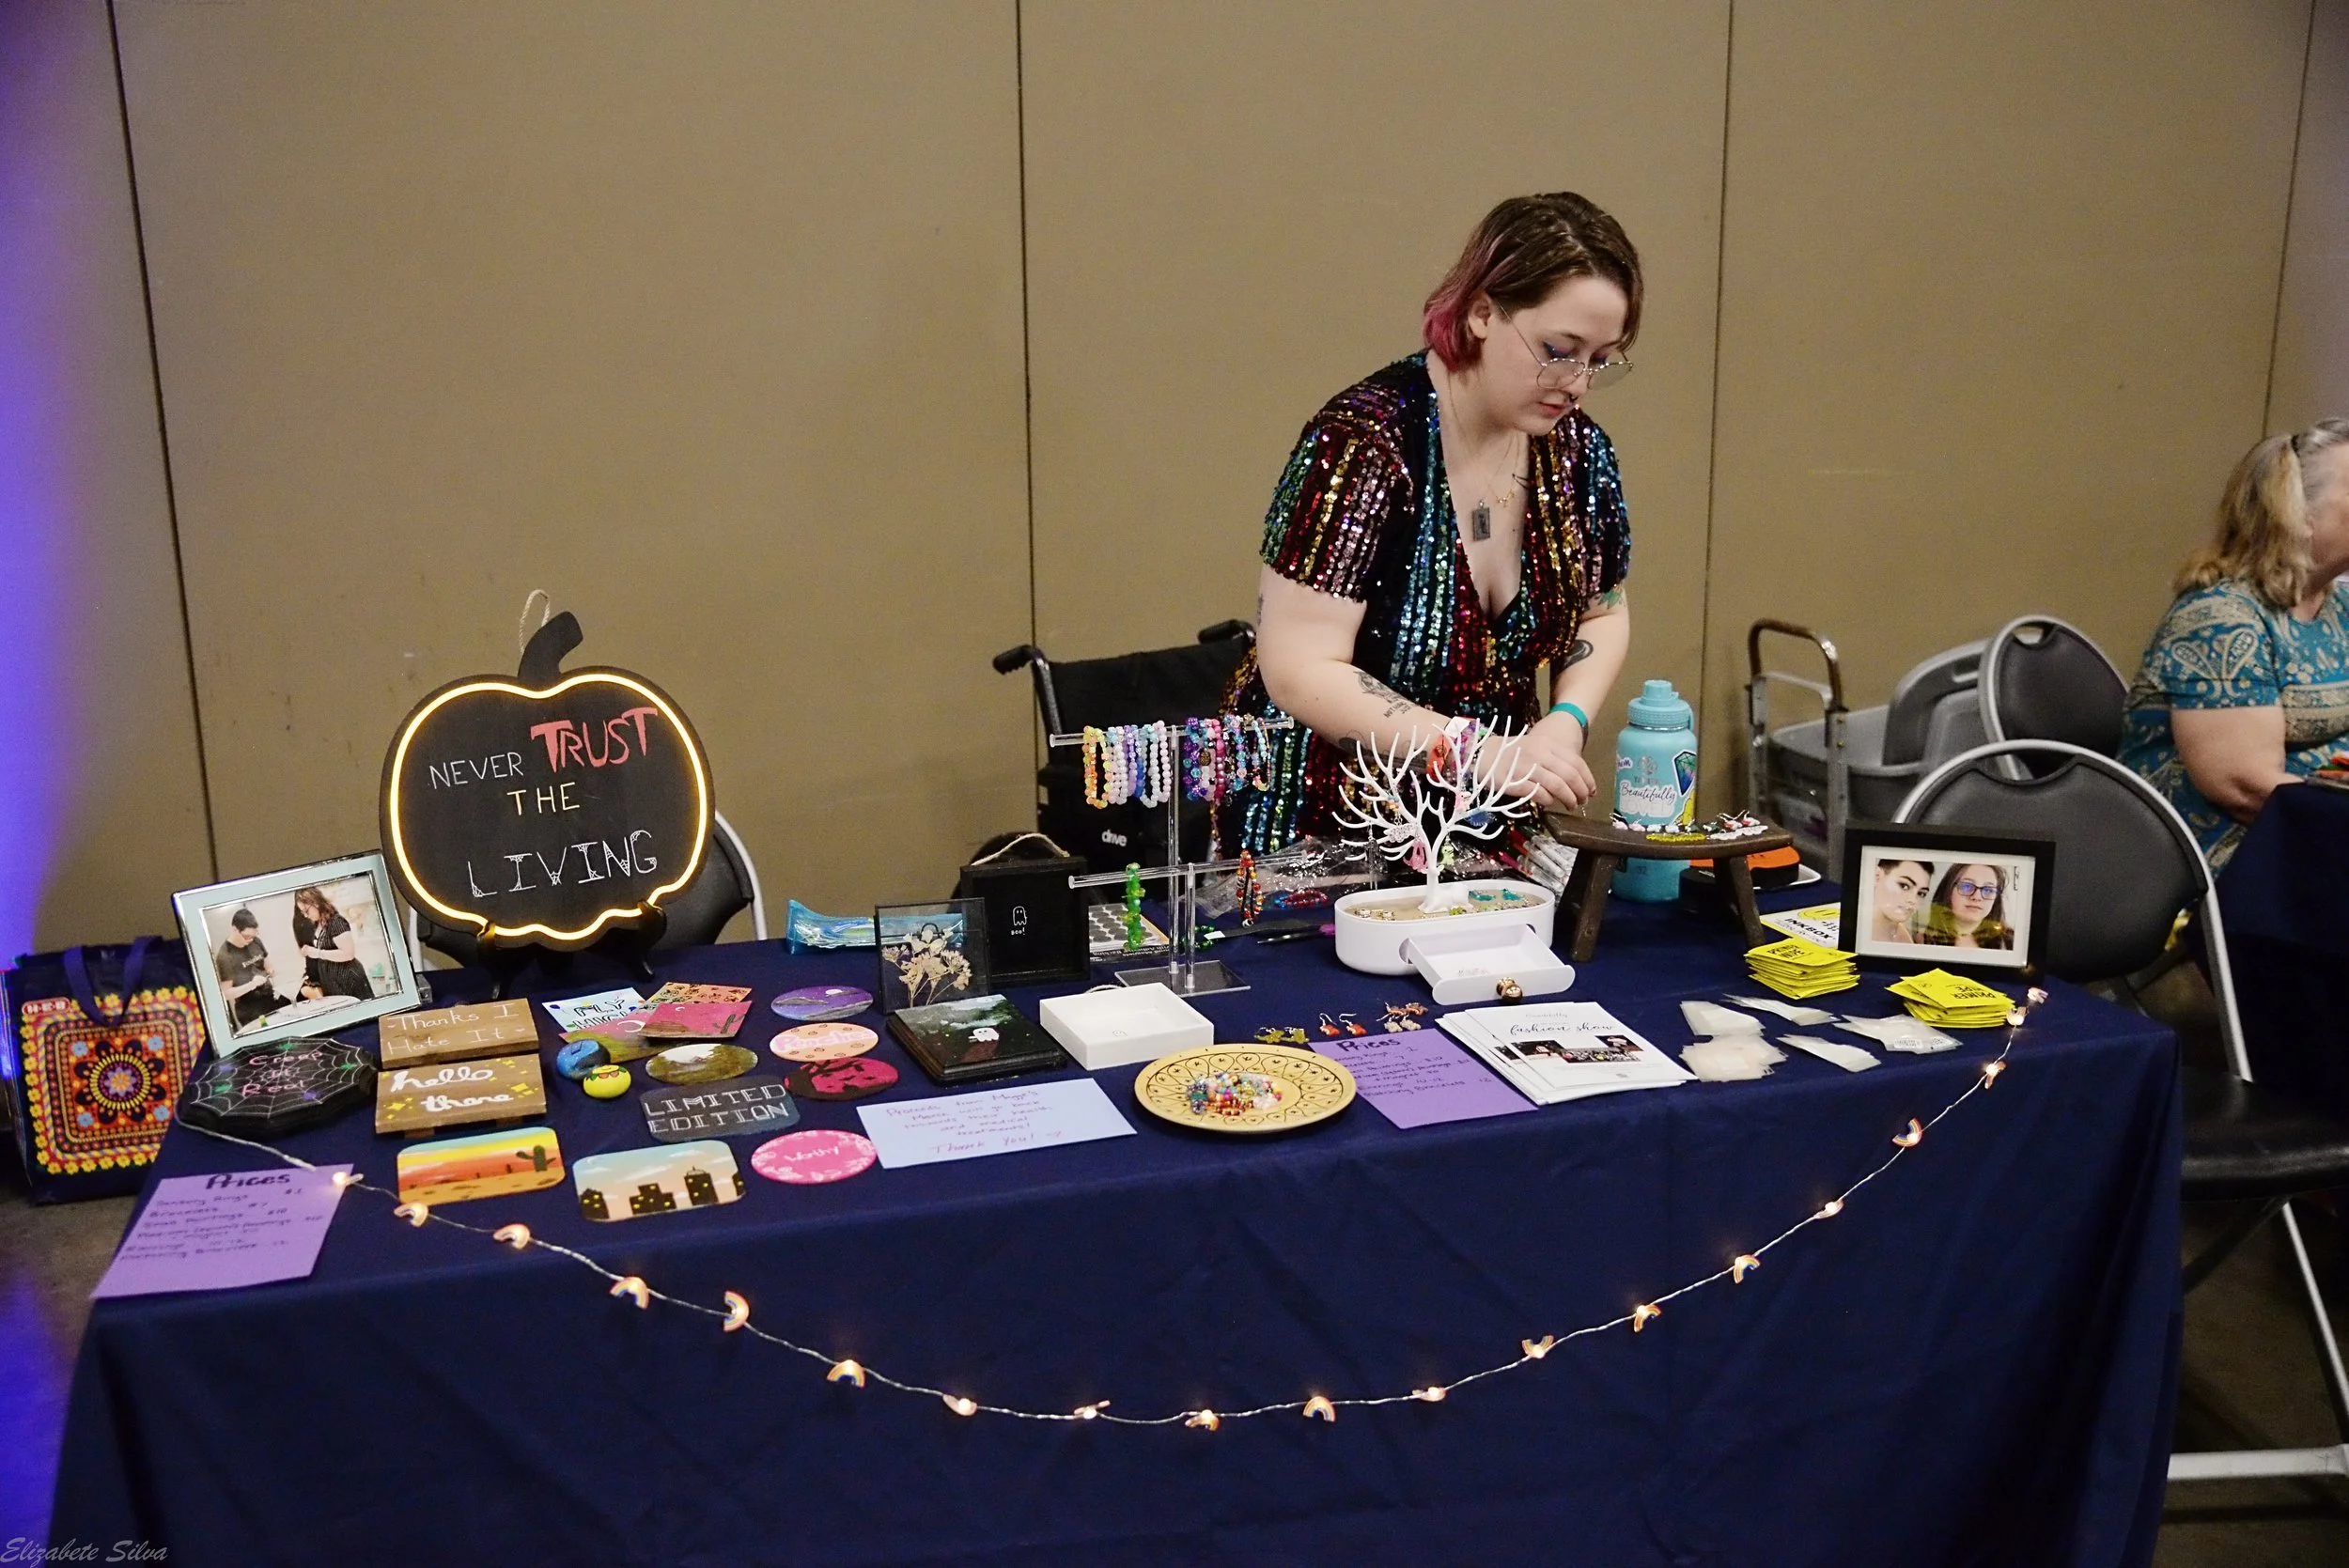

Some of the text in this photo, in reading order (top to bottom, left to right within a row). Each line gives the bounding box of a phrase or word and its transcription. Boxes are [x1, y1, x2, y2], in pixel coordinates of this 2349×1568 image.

[429, 707, 658, 789] NEVER TRUST
[507, 782, 580, 815] THE
[1621, 782, 1675, 805] Beautifully
[468, 830, 658, 897] LIVING
[1784, 918, 1832, 939] INKBOX
[386, 1002, 520, 1031] Thanks I
[1510, 1021, 1613, 1035] fashion show
[387, 1028, 505, 1055] Hate It
[1336, 1038, 1401, 1052] Prices
[249, 1050, 322, 1065] Creep
[242, 1079, 309, 1097] Real
[390, 1065, 494, 1093] hello
[420, 1094, 514, 1112] there
[644, 1083, 786, 1117] LIMITED
[646, 1102, 789, 1133] EDITION
[206, 1173, 290, 1190] Prices
